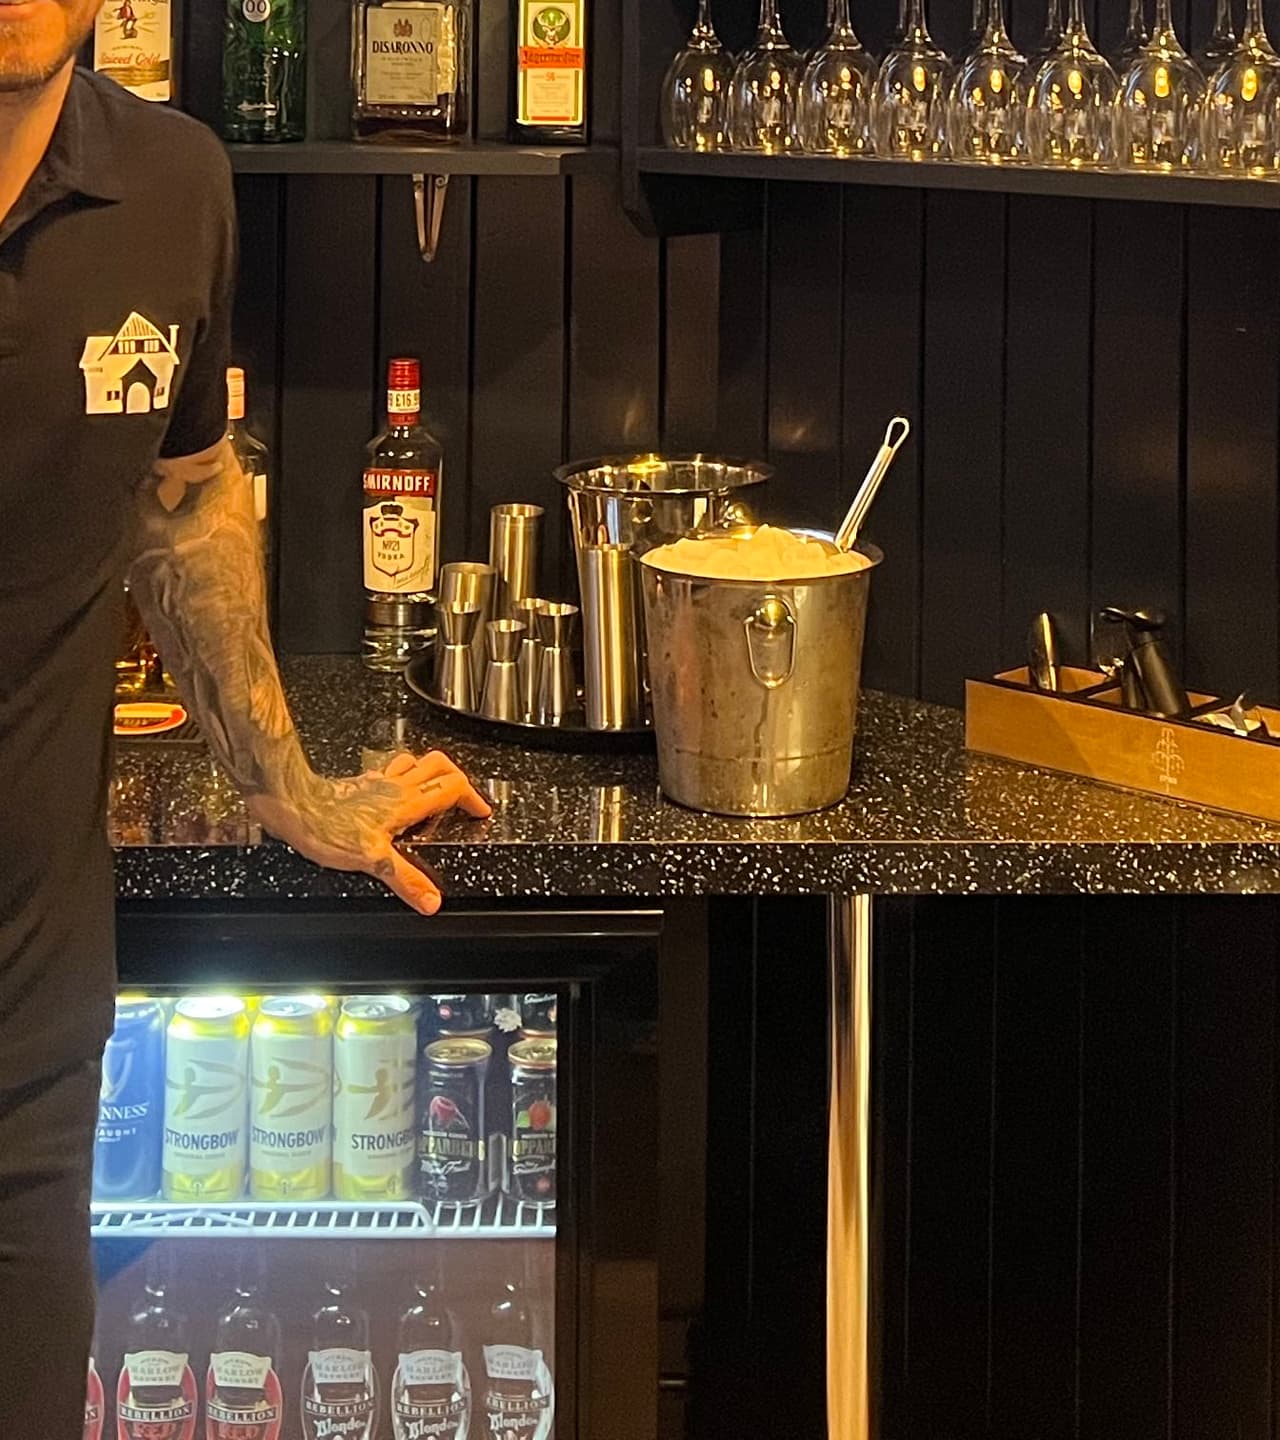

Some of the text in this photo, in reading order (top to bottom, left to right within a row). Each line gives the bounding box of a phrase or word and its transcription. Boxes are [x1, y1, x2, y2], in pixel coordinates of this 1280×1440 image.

[372, 40, 434, 55] DISARONNO
[100, 1101, 151, 1122] NNESS
[165, 1128, 240, 1151] STRONGBOW
[251, 1125, 328, 1149] STRONGBOW
